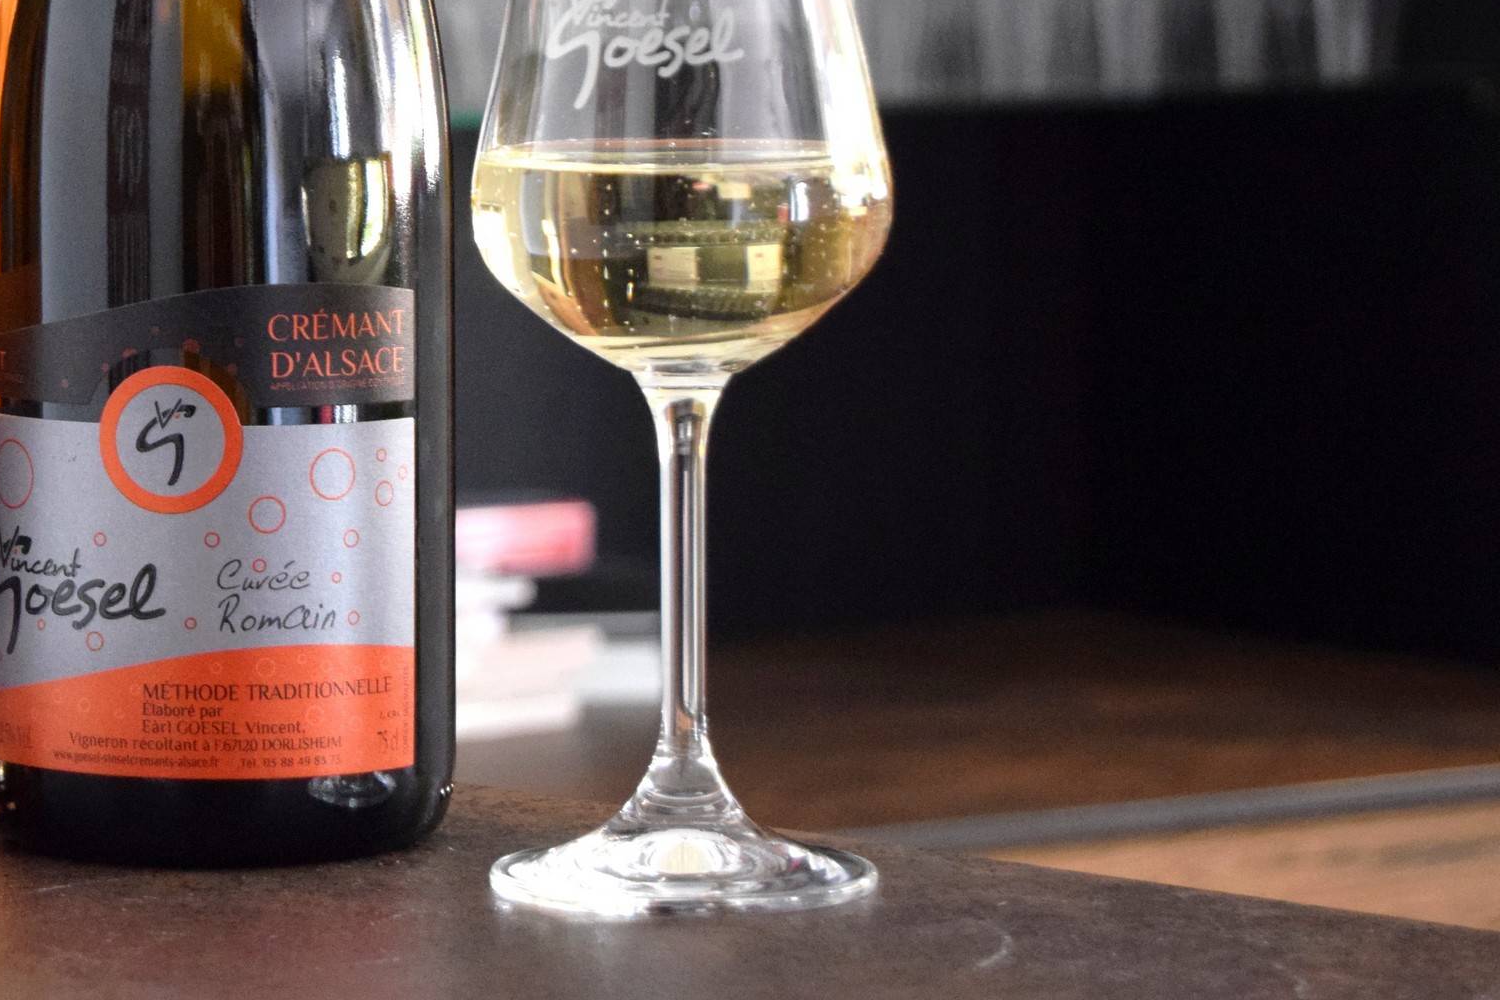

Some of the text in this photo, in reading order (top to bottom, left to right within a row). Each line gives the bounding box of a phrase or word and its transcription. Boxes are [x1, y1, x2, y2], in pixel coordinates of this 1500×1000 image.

[267, 308, 405, 342] CRÉMANT
[271, 346, 405, 378] D'ALSACE
[217, 558, 311, 591] Cuvée
[218, 593, 336, 633] Romain
[143, 676, 392, 701] MÉTHODE TRADITIONNELLE
[142, 701, 223, 721] Élaboré par
[177, 720, 240, 735] GOESEL
[69, 731, 128, 749] Vigneron
[203, 739, 210, 751] à
[262, 736, 342, 751] DORLISHEIM
[281, 757, 294, 767] 88
